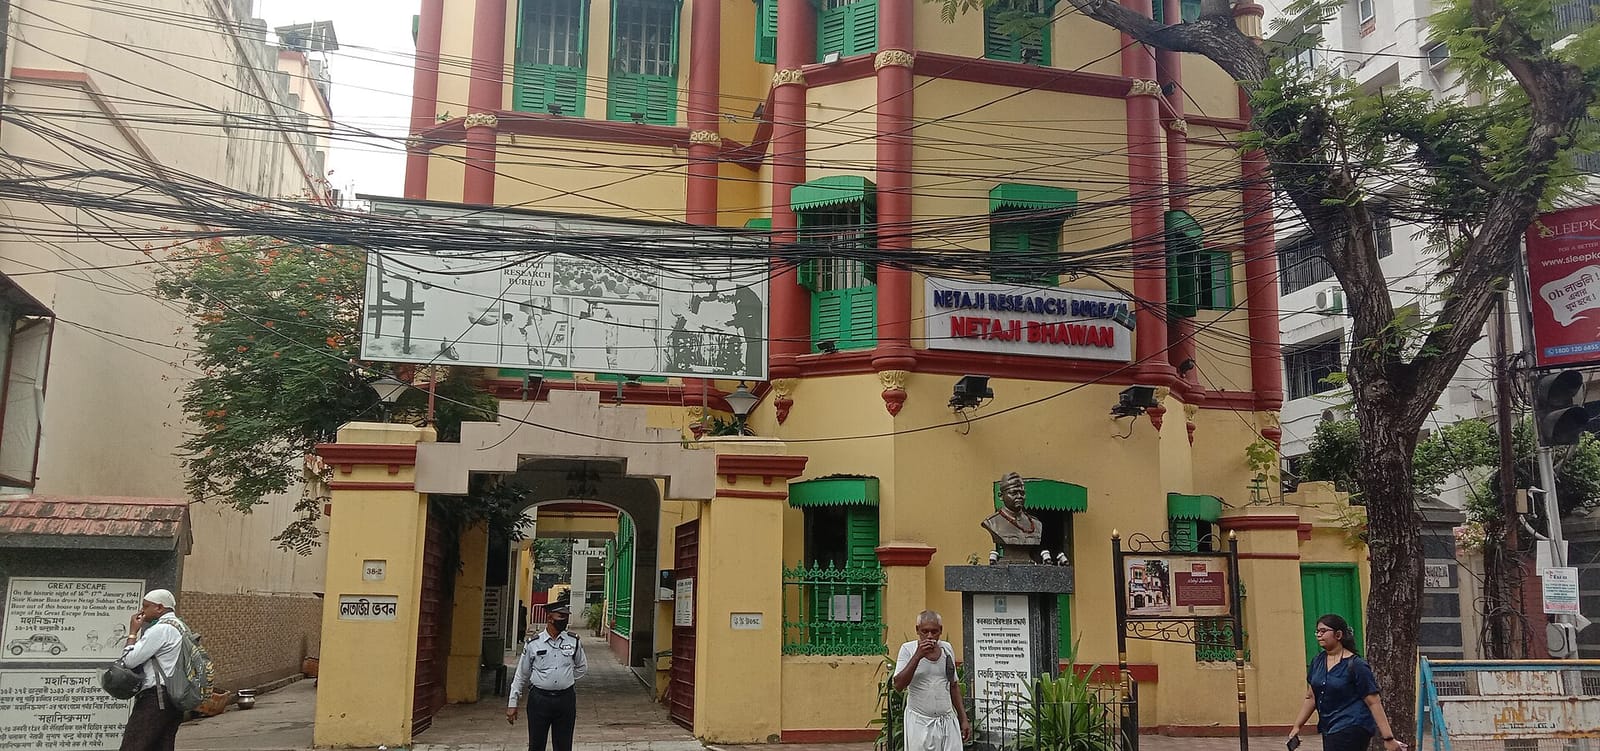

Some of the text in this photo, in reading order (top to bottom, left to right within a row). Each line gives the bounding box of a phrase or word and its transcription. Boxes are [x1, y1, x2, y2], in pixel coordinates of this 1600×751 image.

[504, 268, 551, 279] RESEARCH
[509, 278, 546, 287] BUREAU
[1548, 289, 1564, 301] Oh
[934, 289, 1127, 319] NETAJI RESEARCH BUREA
[951, 315, 1114, 348] NETAJI BHAWAN
[47, 582, 73, 590] GREAT
[340, 598, 397, 616] নেতাজী ভবন
